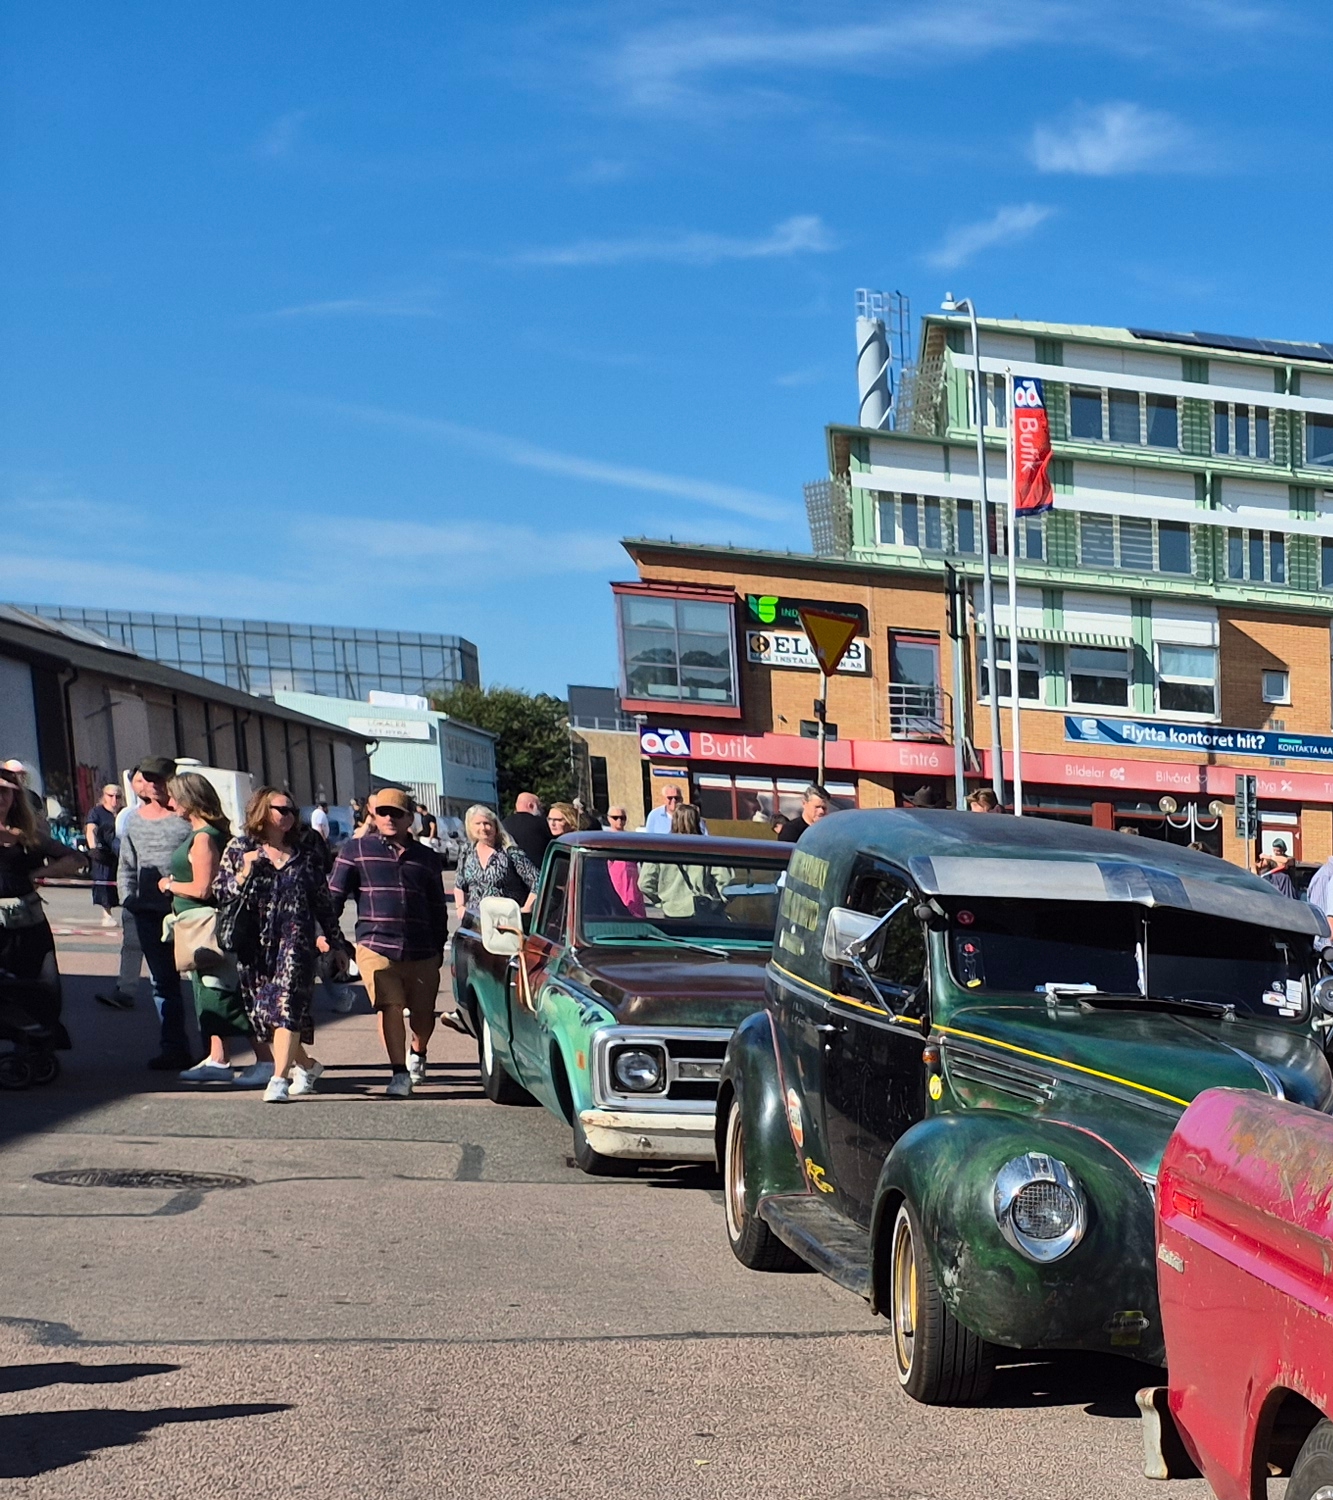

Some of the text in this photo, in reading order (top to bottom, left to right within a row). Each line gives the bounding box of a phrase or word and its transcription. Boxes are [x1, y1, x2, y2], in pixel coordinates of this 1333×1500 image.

[1019, 417, 1043, 475] Butik
[700, 733, 755, 759] Butik
[1122, 725, 1266, 750] Flytta kontoret hit?
[1278, 743, 1321, 754] KONTAKTA
[900, 747, 939, 768] Entré
[1065, 764, 1191, 784] Bildelar Bilvård
